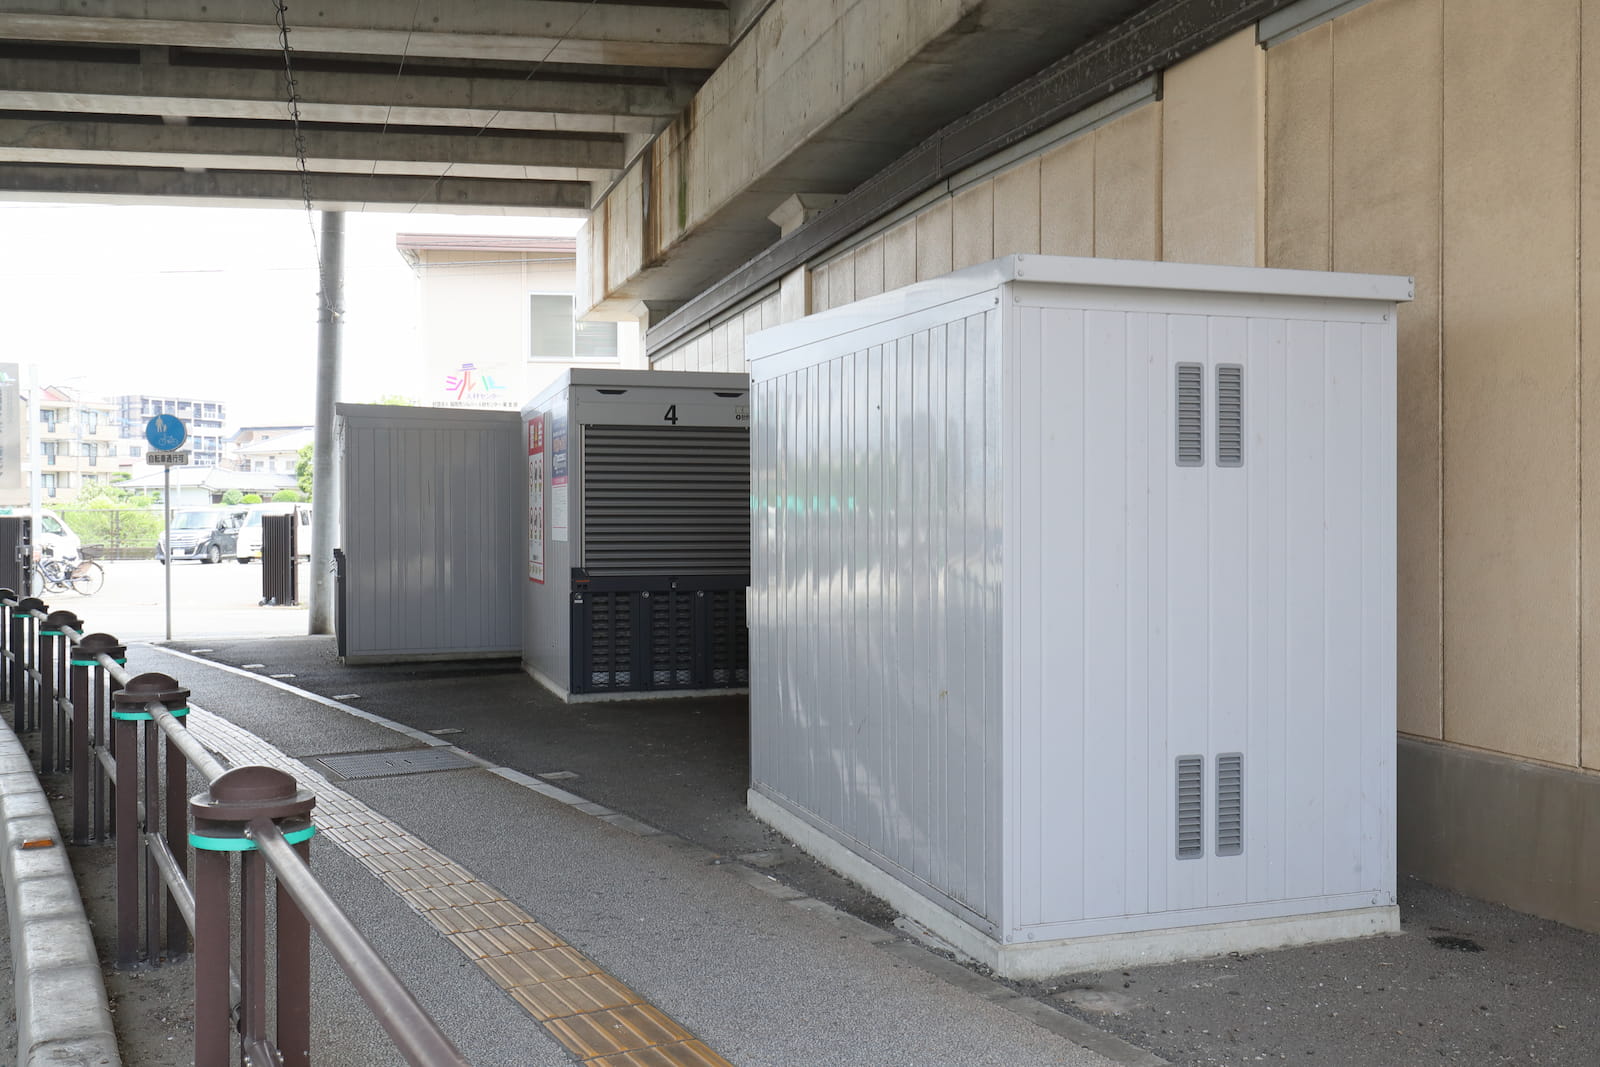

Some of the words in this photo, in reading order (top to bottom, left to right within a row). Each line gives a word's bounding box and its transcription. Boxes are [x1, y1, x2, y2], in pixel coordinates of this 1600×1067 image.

[664, 404, 678, 425] 4
[148, 454, 184, 463] 自転車通行可
